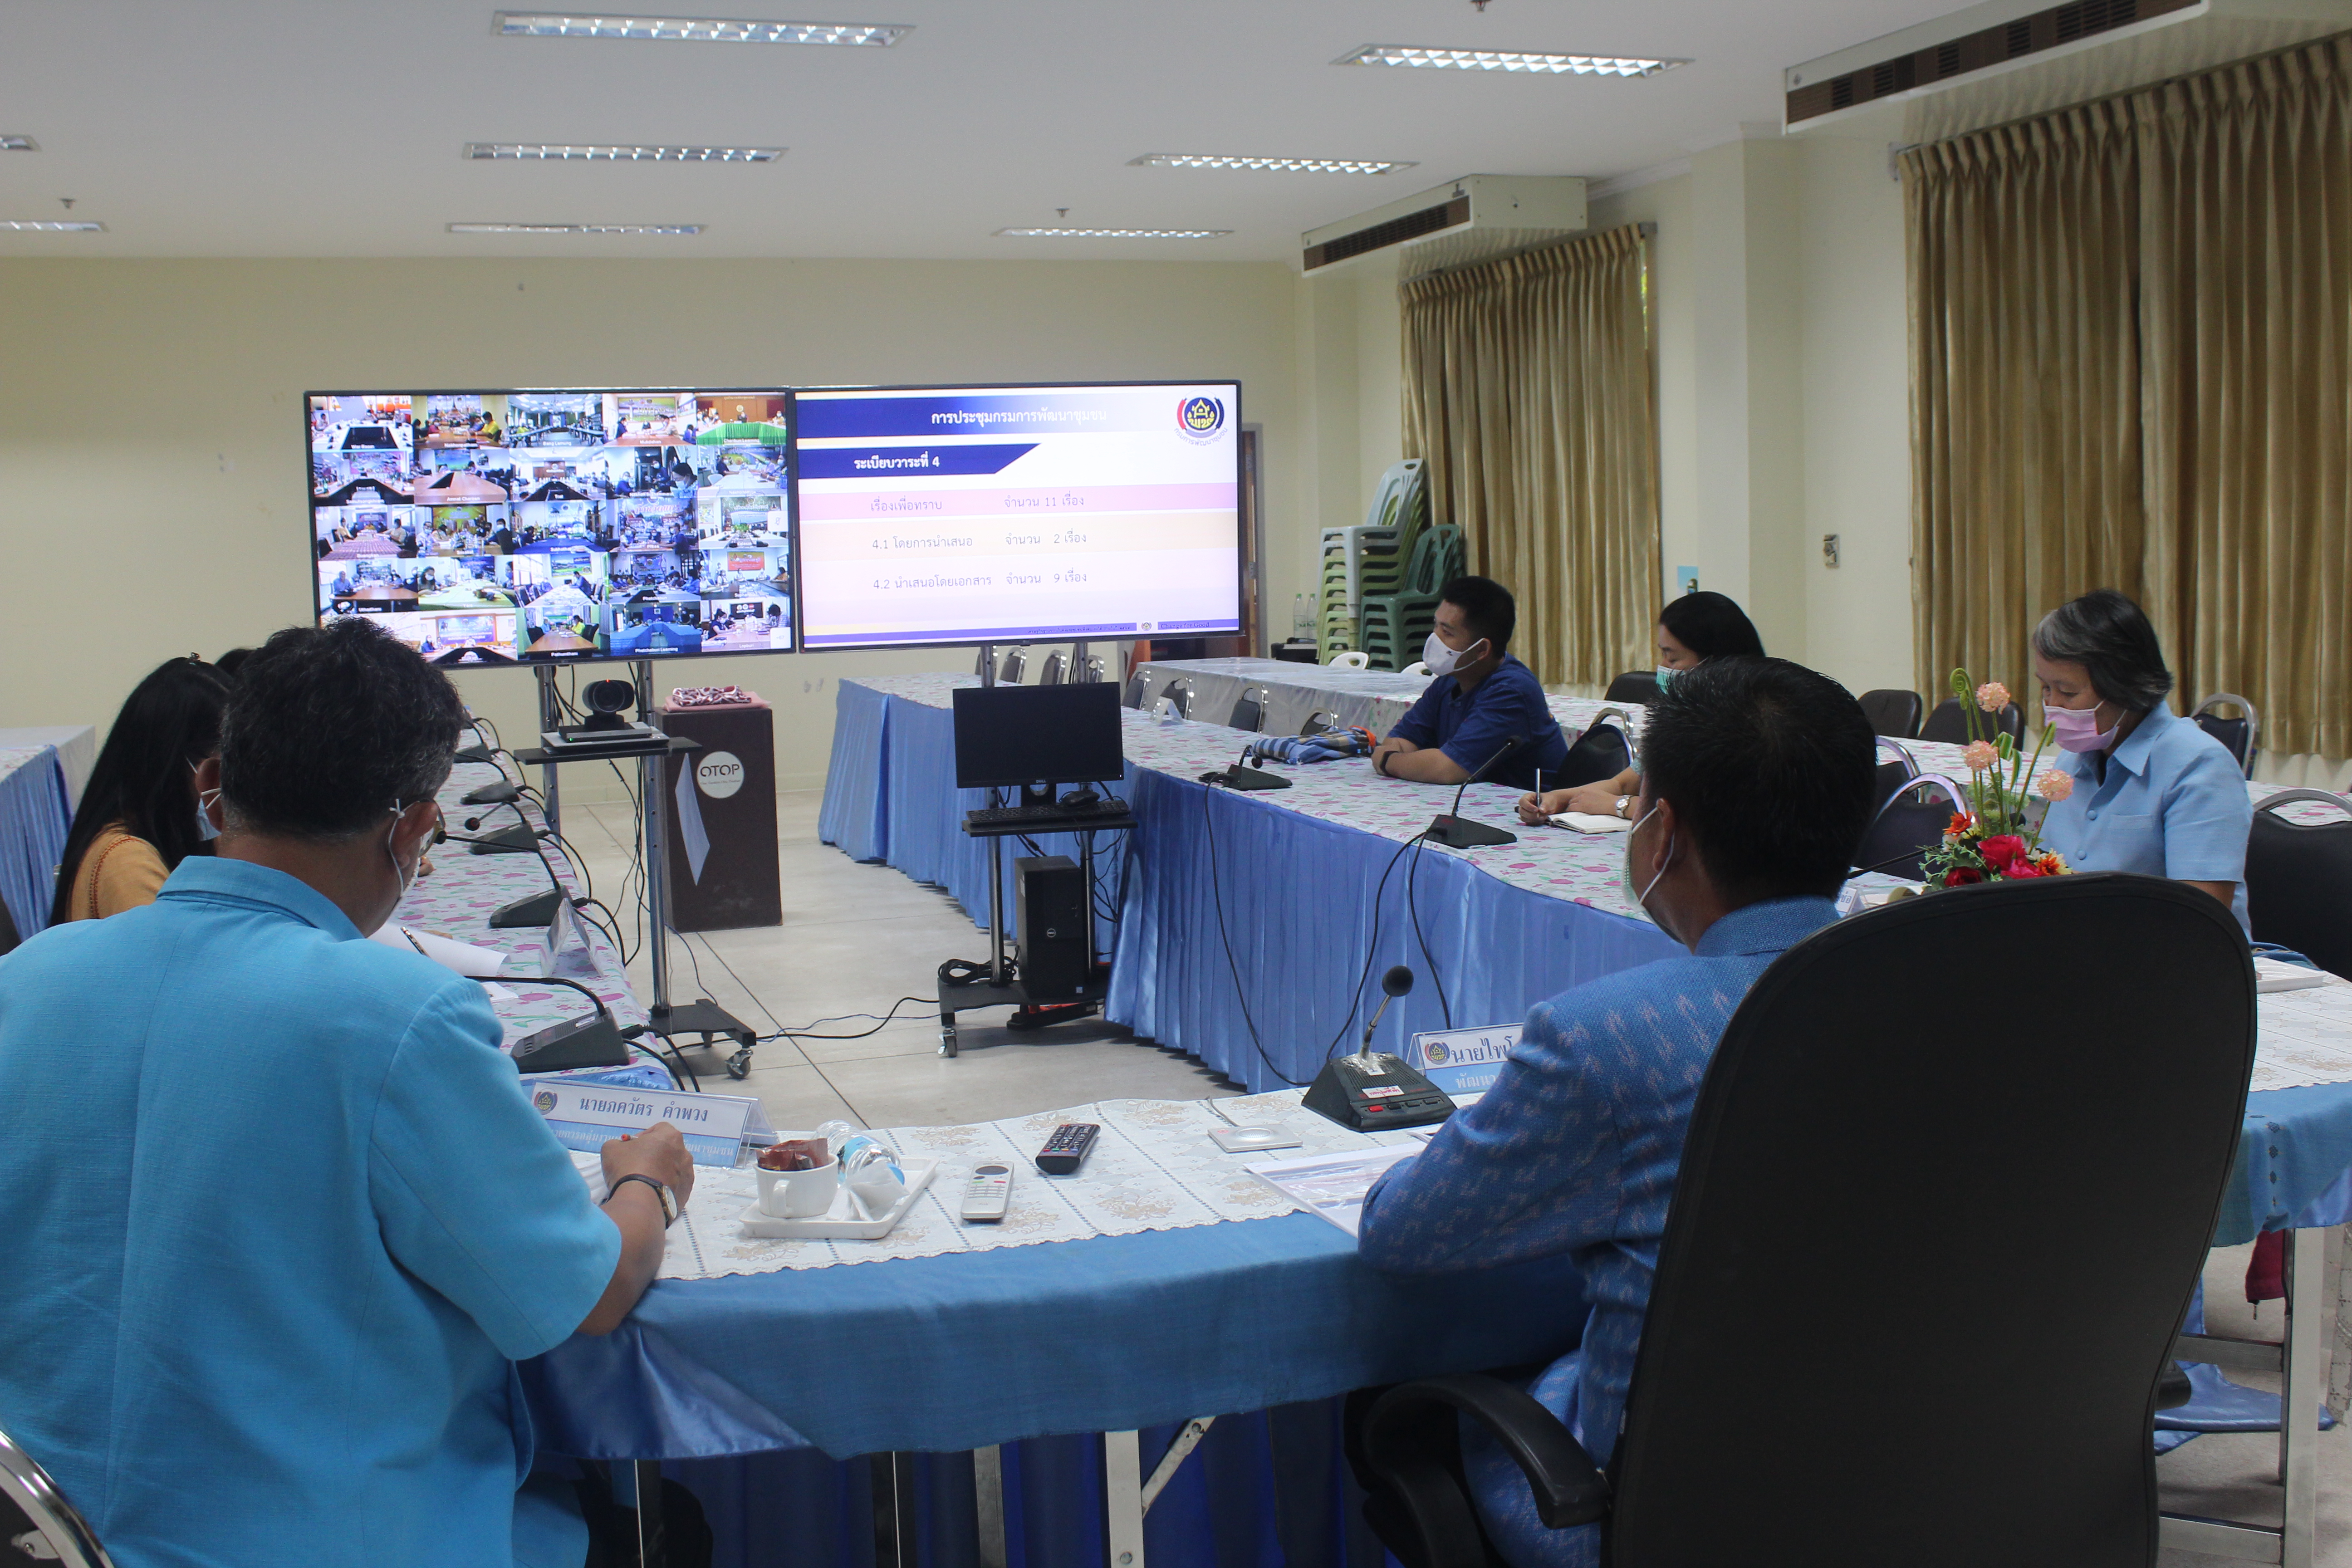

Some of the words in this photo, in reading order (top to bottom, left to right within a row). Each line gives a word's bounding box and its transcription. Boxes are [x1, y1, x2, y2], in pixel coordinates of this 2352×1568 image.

[931, 407, 1107, 427] การประชุมกรมการพัฒนาชุมชน
[1174, 427, 1228, 446] กรมการพัฒนาชุมชน
[853, 451, 929, 470] ระเบียบวาระที่
[932, 456, 940, 467] 4
[870, 495, 943, 511] เรื่องเพื่อทราบ
[1004, 495, 1040, 508] จำนวน
[1044, 496, 1057, 507] 11
[1062, 491, 1085, 506] เรื่อง
[872, 539, 888, 549] 4.1
[892, 534, 973, 549] โดยการนำเสนอ
[1005, 532, 1041, 545] จำนวน
[1053, 534, 1060, 544] 2
[1064, 528, 1087, 543] เรื่อง
[873, 578, 890, 589] 4.2
[894, 574, 992, 588] นำเสนอโดยเอกสาร
[1006, 572, 1041, 585] จำนวน
[1054, 573, 1060, 583] 9
[1065, 567, 1087, 583] เรื่อง
[700, 764, 740, 777] OTOP
[579, 1097, 654, 1117] นายภควัตร
[662, 1100, 708, 1122] คำพวง
